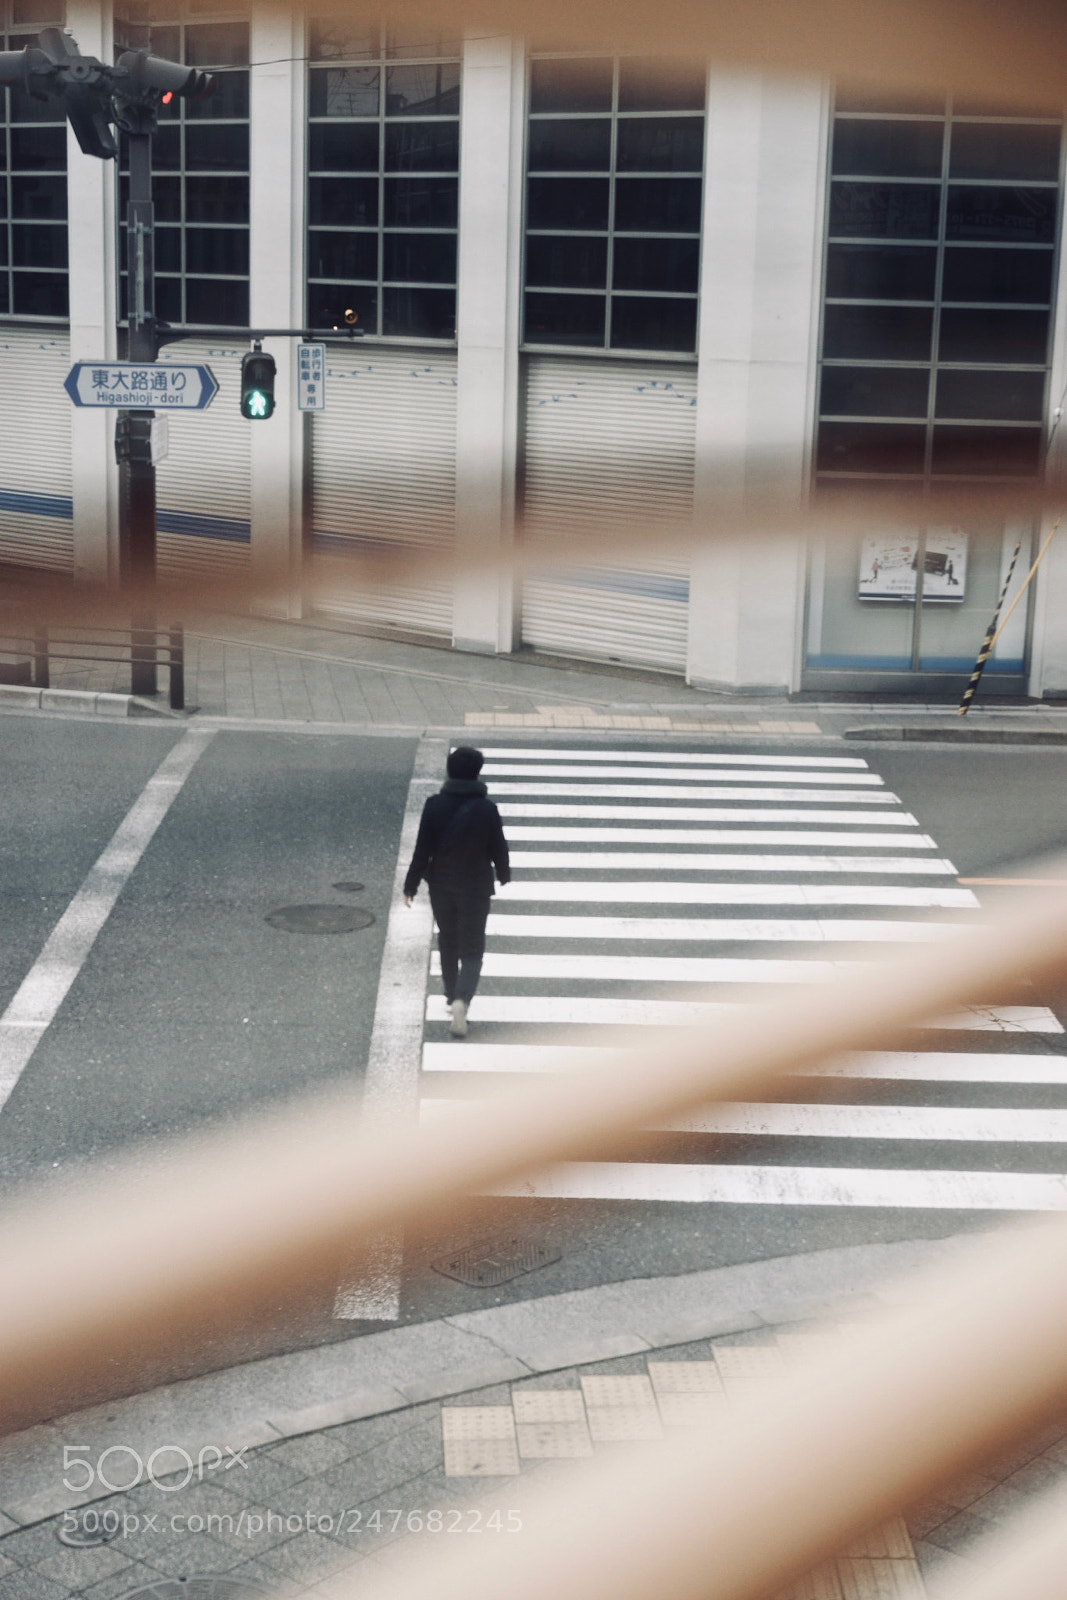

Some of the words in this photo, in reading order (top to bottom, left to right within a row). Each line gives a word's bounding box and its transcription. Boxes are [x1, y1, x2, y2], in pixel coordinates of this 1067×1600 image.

[301, 348, 310, 381] 自転車
[312, 348, 321, 381] 歩行者
[91, 369, 187, 391] 東大路通り
[97, 392, 184, 405] Higashioji-dori
